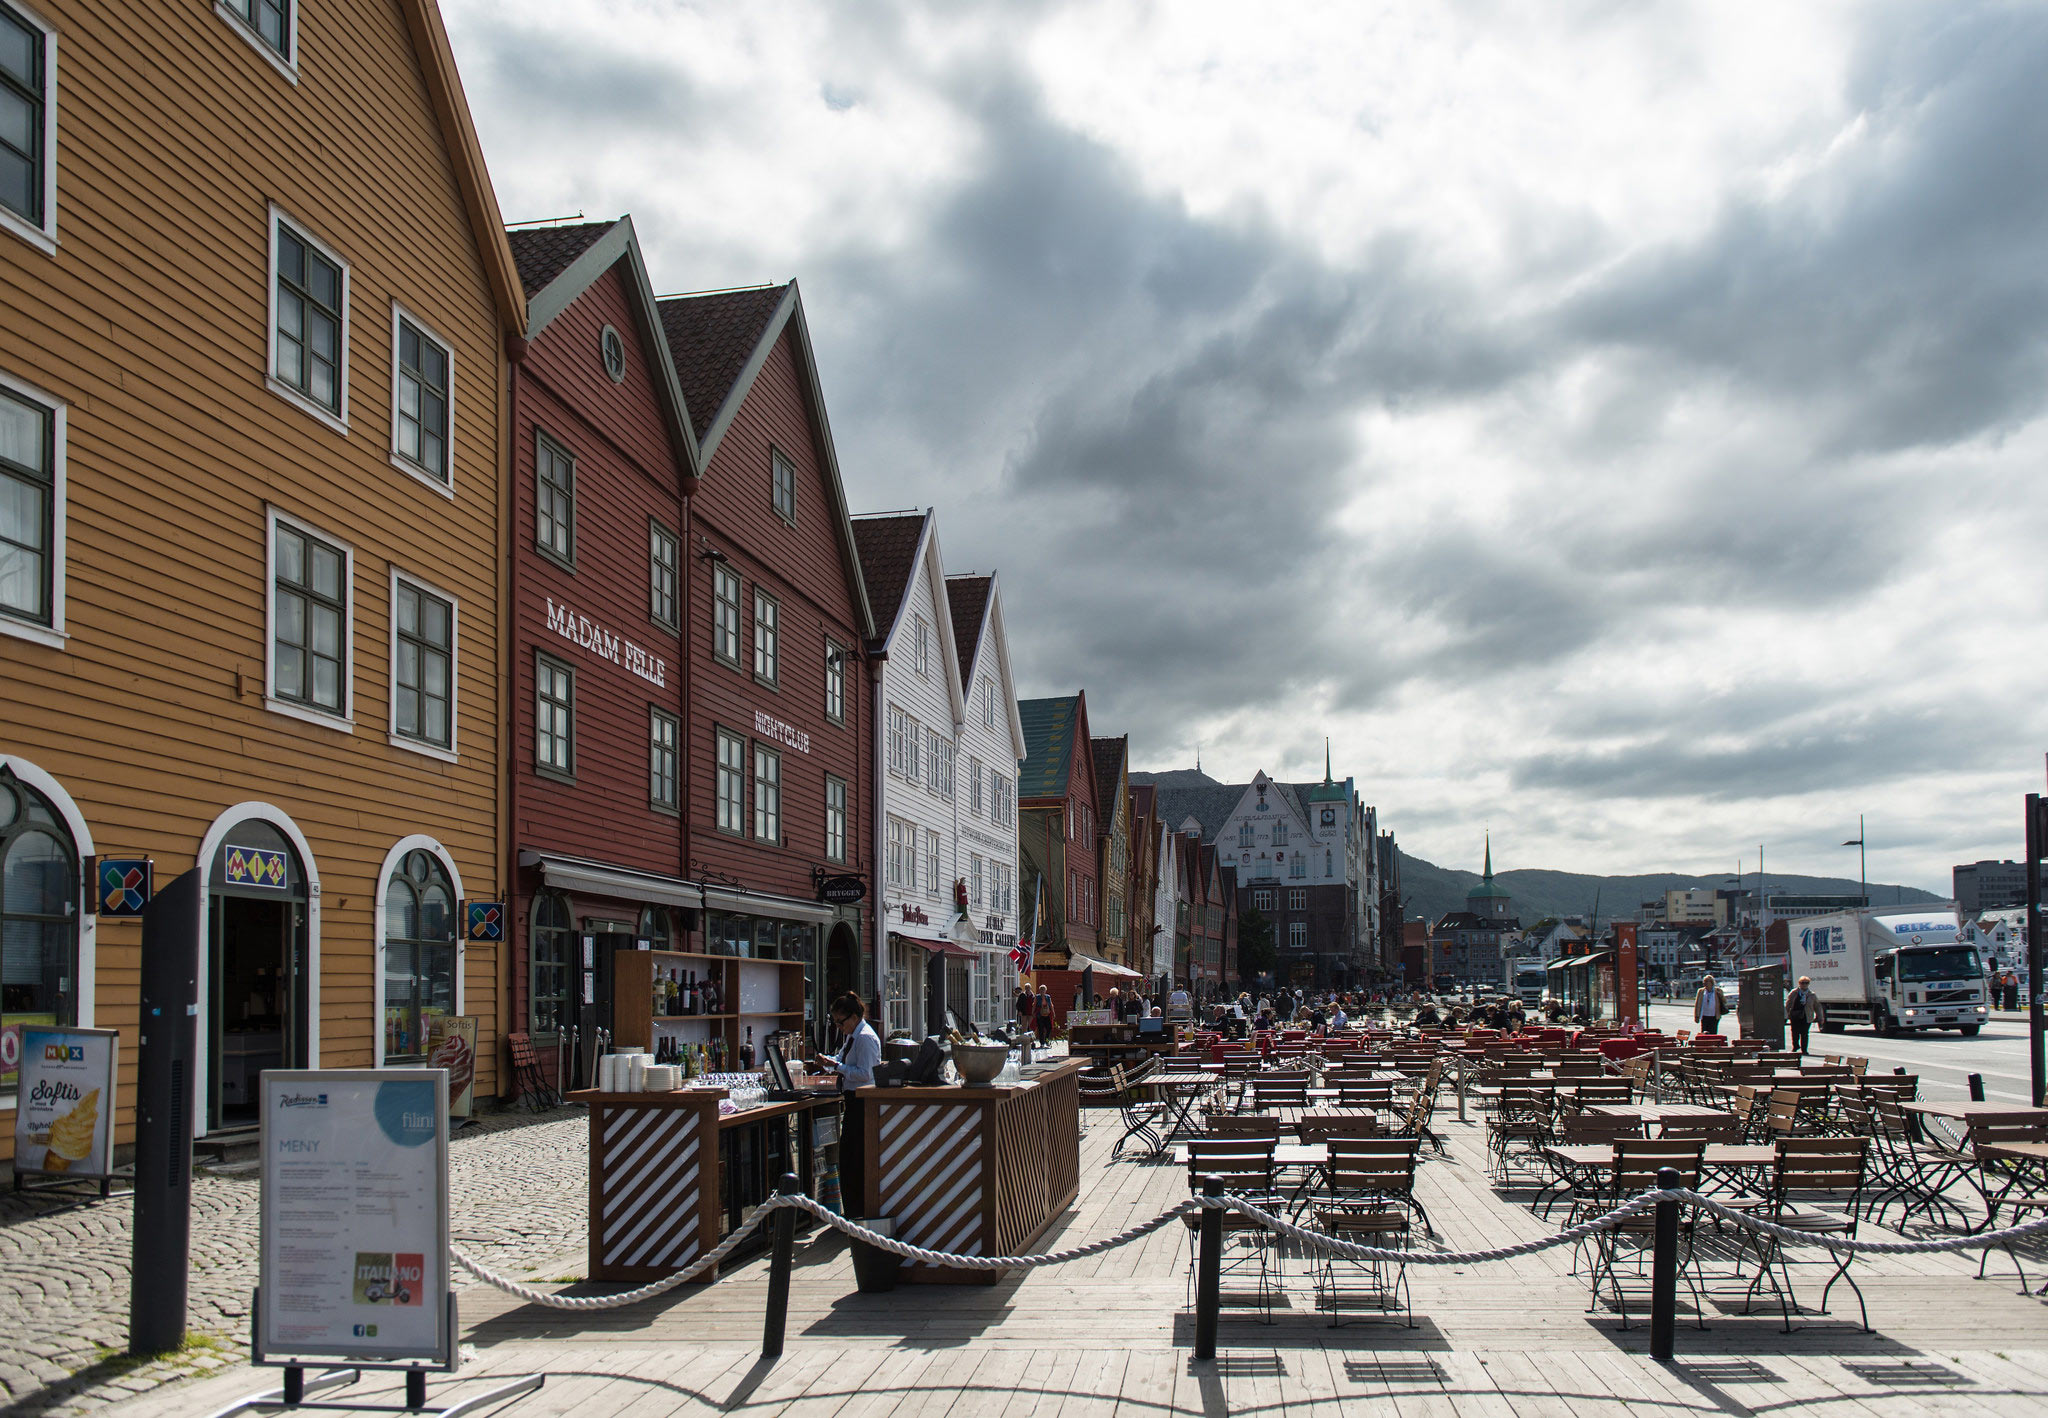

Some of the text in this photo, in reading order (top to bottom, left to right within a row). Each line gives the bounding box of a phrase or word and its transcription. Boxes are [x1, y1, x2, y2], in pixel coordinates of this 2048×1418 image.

[546, 596, 665, 689] MADAM FELLE
[755, 709, 810, 754] NIGHTCLUB
[228, 853, 282, 880] MIX
[826, 889, 861, 897] BRYGGEN
[1621, 938, 1631, 949] A
[1813, 927, 1830, 951] BIK
[447, 1019, 472, 1030] Softis
[46, 1047, 81, 1060] MIX
[30, 1079, 82, 1106] Softis
[279, 1092, 319, 1109] Radisson
[402, 1112, 434, 1128] filini
[279, 1140, 321, 1153] MENY
[357, 1265, 421, 1281] ITALIANO
